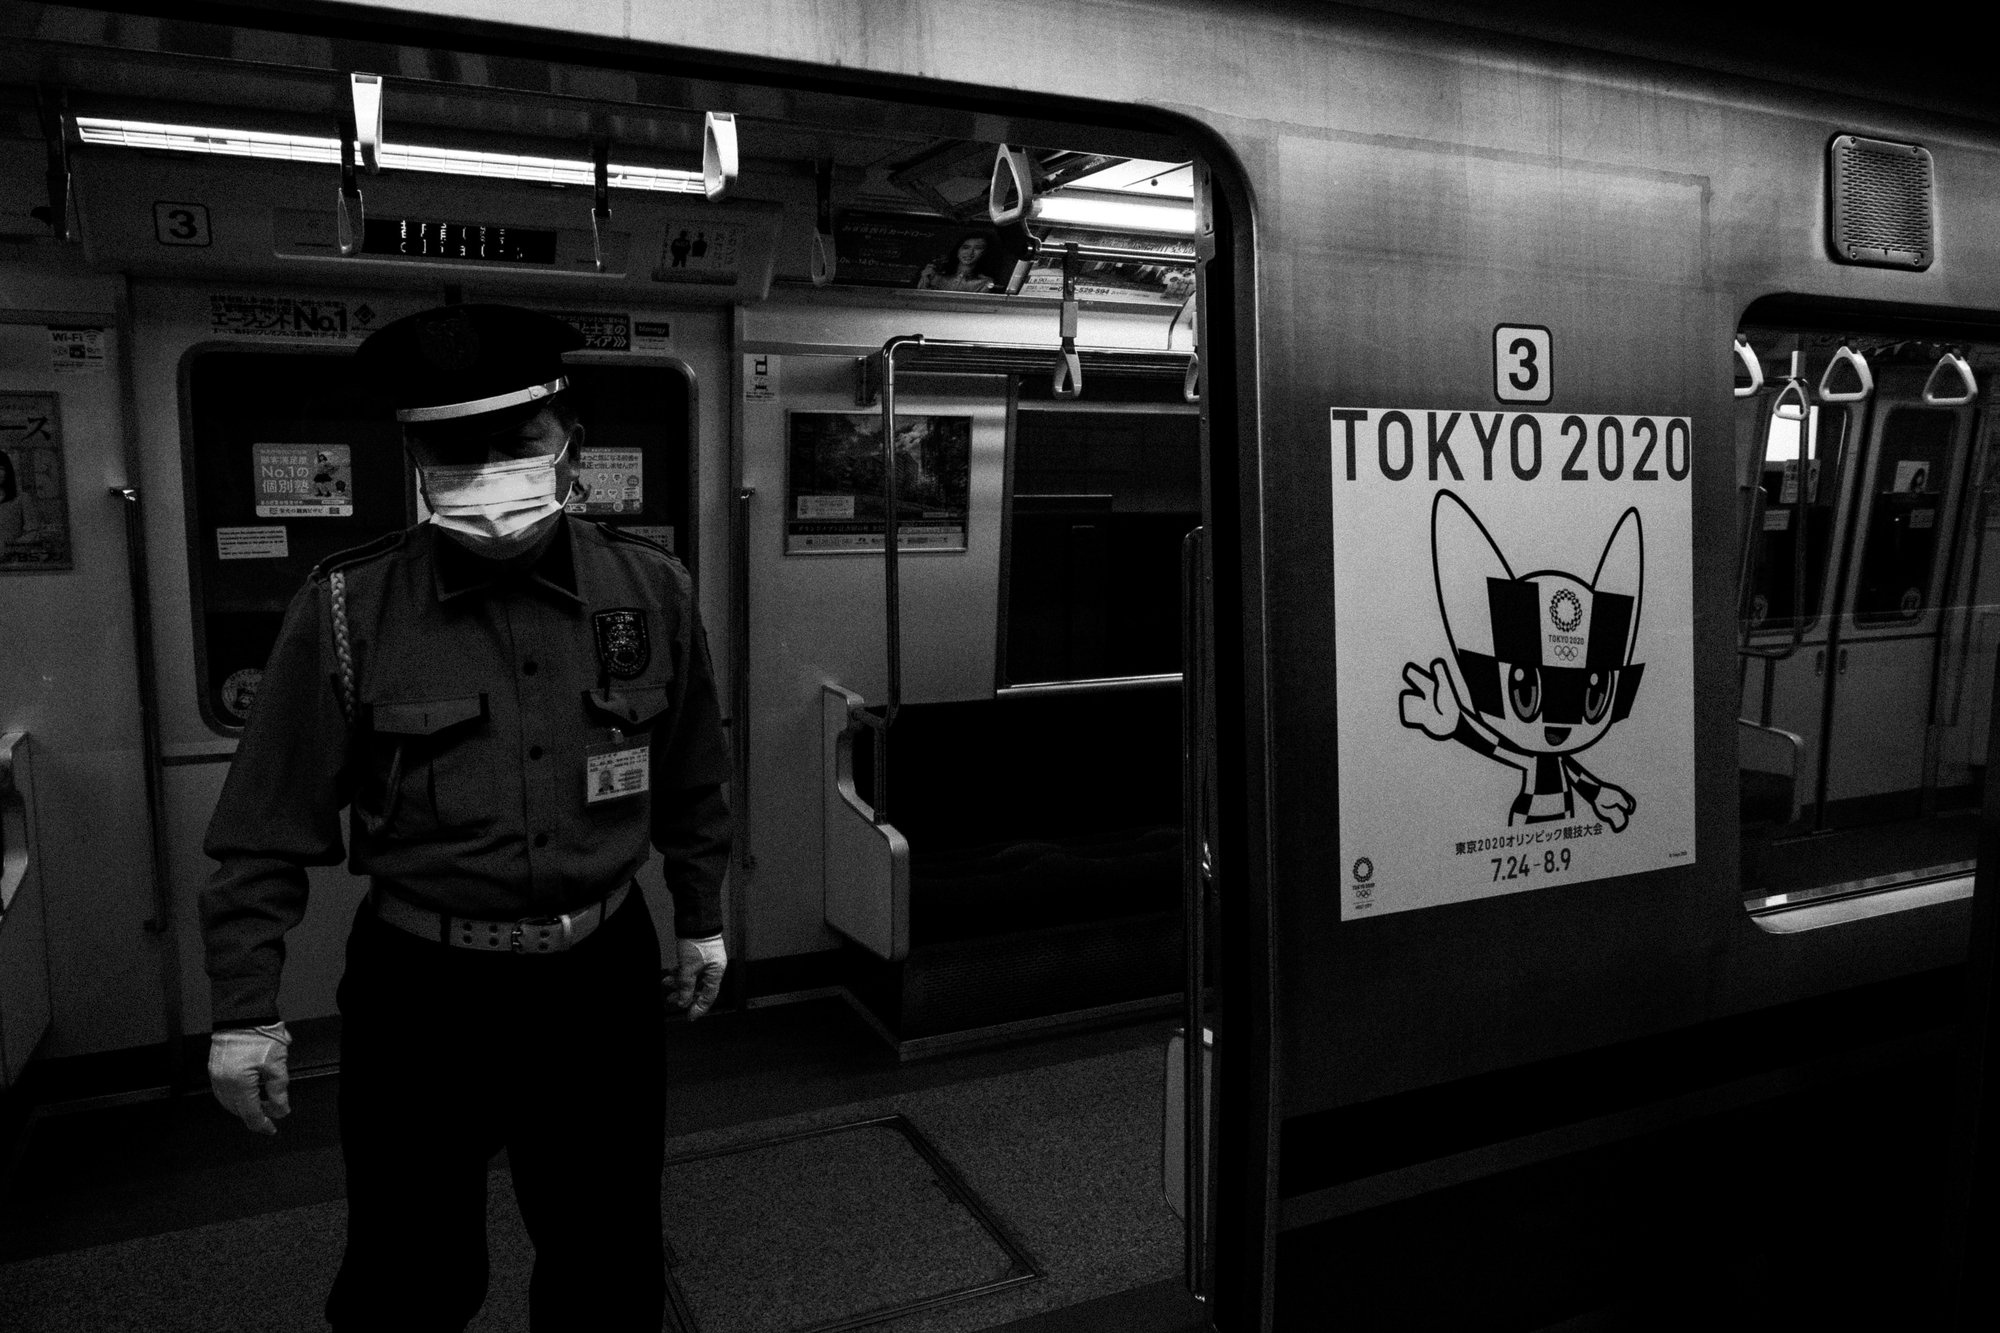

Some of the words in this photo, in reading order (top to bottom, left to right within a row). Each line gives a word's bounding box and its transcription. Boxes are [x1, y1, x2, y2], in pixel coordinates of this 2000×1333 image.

[168, 209, 198, 239] 3
[52, 332, 84, 342] Wi-Fi
[1509, 338, 1540, 392] 3
[1332, 409, 1543, 482] TOKYO
[1561, 415, 1691, 482] 2020
[1548, 634, 1568, 643] TOKYO
[1570, 636, 1584, 645] 2020
[1455, 822, 1604, 855] 東京2020オリンピック競技大会
